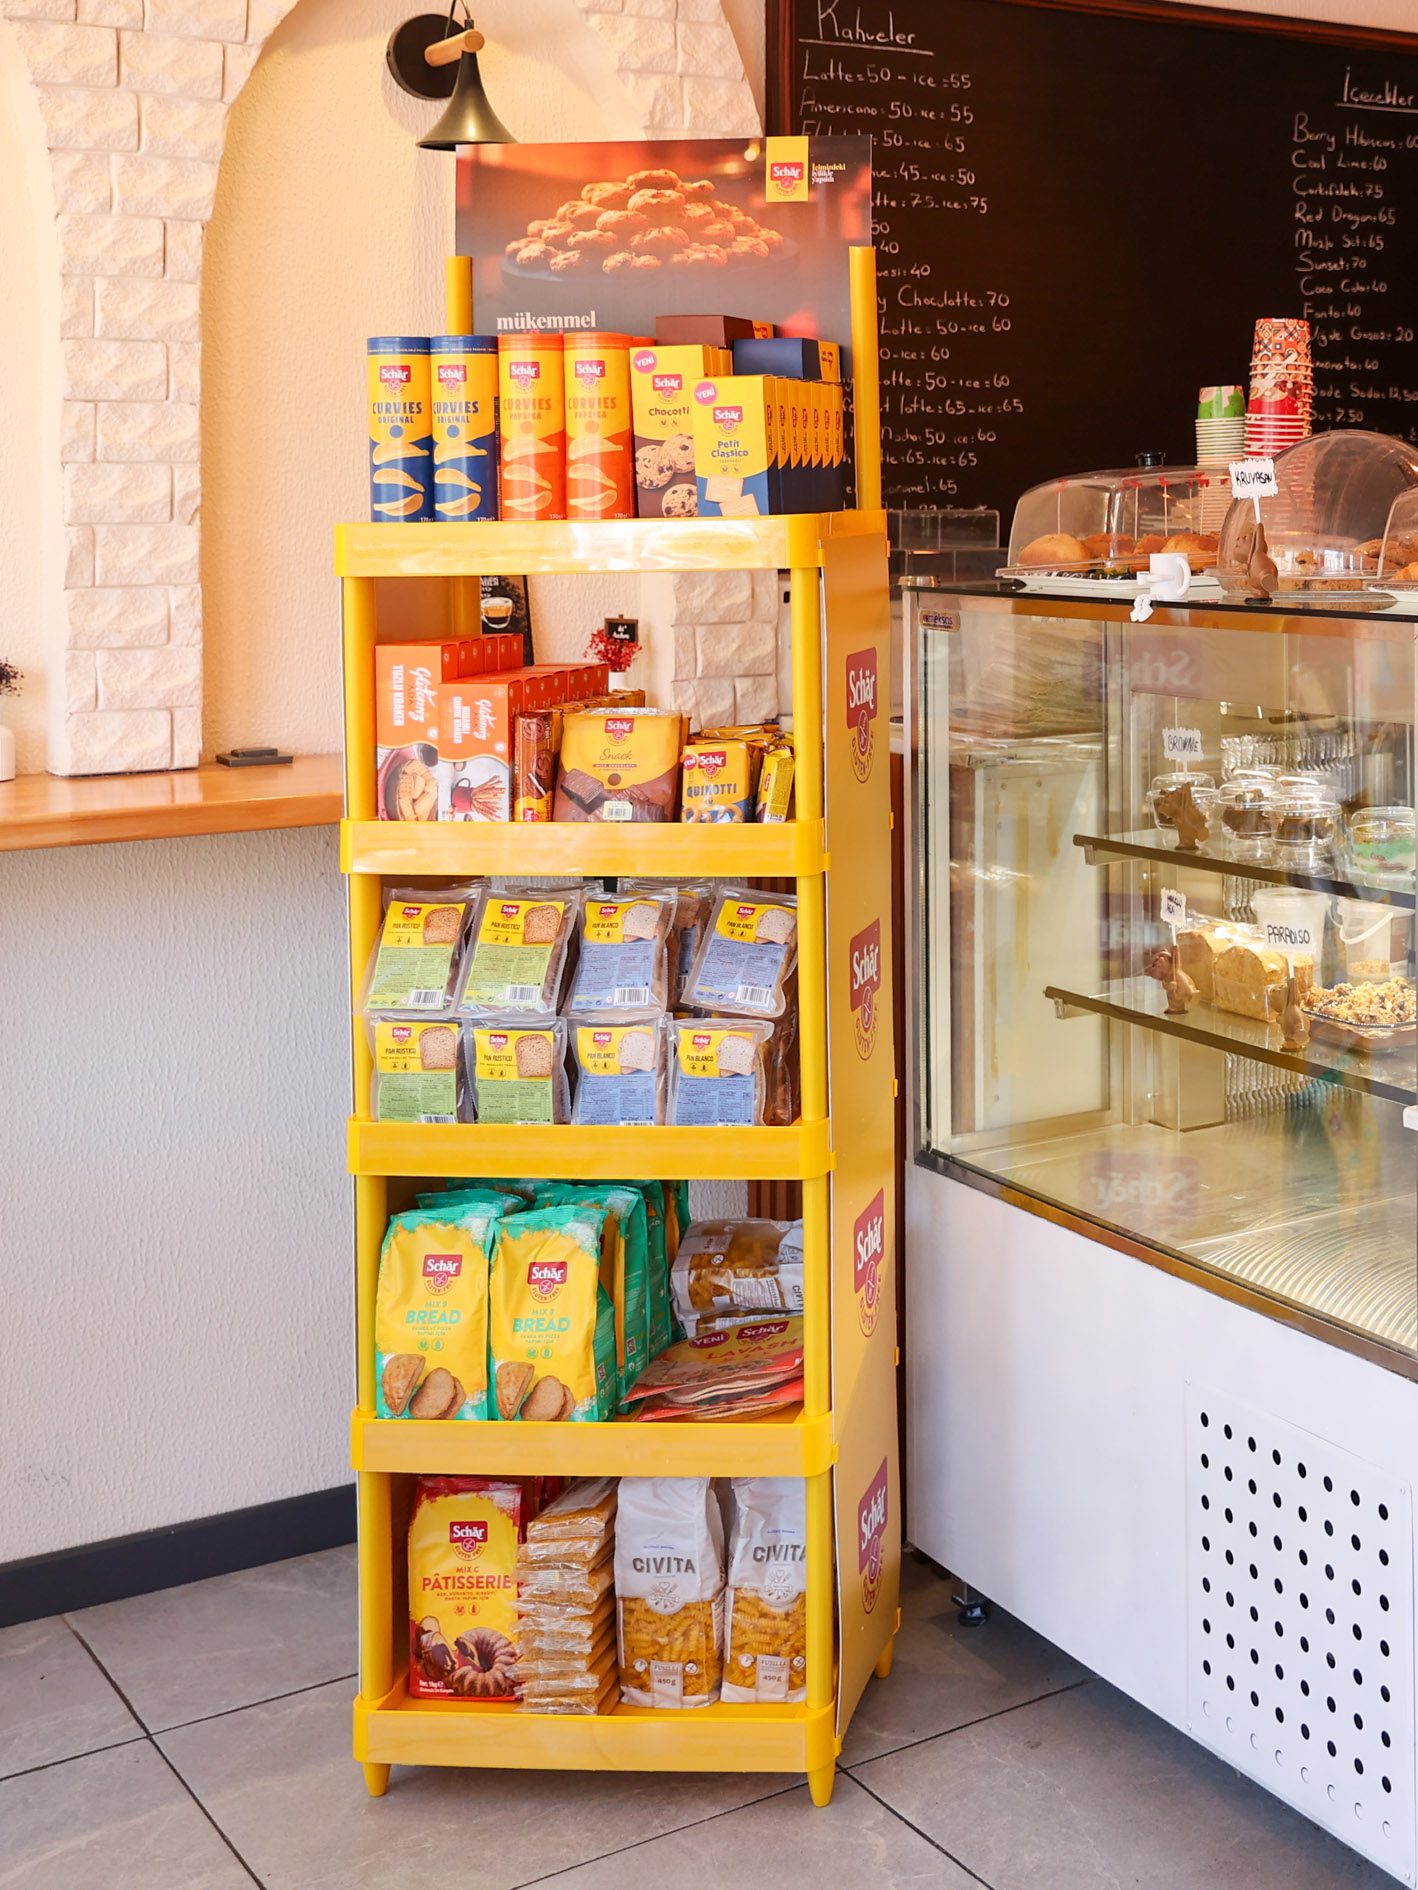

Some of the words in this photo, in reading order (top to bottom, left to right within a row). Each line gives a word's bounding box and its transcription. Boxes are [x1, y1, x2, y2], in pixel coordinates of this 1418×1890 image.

[773, 166, 801, 178] Schär
[1294, 201, 1323, 223] Red
[496, 310, 597, 330] mükemmel
[381, 369, 408, 381] Schär
[439, 369, 465, 381] Schär
[511, 365, 538, 377] Schär
[576, 364, 603, 376] Schär
[653, 377, 681, 389] Schär
[372, 401, 423, 414] CURVIES
[433, 401, 479, 414] CURVIES
[503, 398, 552, 410] CURVIES
[568, 397, 617, 409] CURVIES
[648, 406, 690, 417] Chocotti
[715, 409, 741, 421] Schär
[717, 439, 740, 449] Petit
[711, 449, 750, 459] Classico
[1235, 471, 1273, 487] KRUVASAN
[849, 669, 875, 711] Schär
[606, 718, 632, 731] Schär
[600, 748, 633, 761] Snack
[700, 754, 725, 766] Schär
[686, 783, 738, 798] QUINOTTI
[1267, 924, 1311, 945] PARADISO
[852, 945, 880, 992] Schär
[856, 1211, 883, 1272] Schär
[426, 1258, 460, 1274] Schär
[531, 1266, 564, 1281] Schär
[405, 1309, 462, 1325] BREAD
[513, 1317, 572, 1332] BREAD
[742, 1322, 784, 1338] Schär
[861, 1489, 887, 1554] Schär
[453, 1524, 486, 1540] Schär
[456, 1566, 473, 1574] MIX
[632, 1556, 696, 1574] CIVITA
[422, 1574, 512, 1591] PÂTISSERIE
